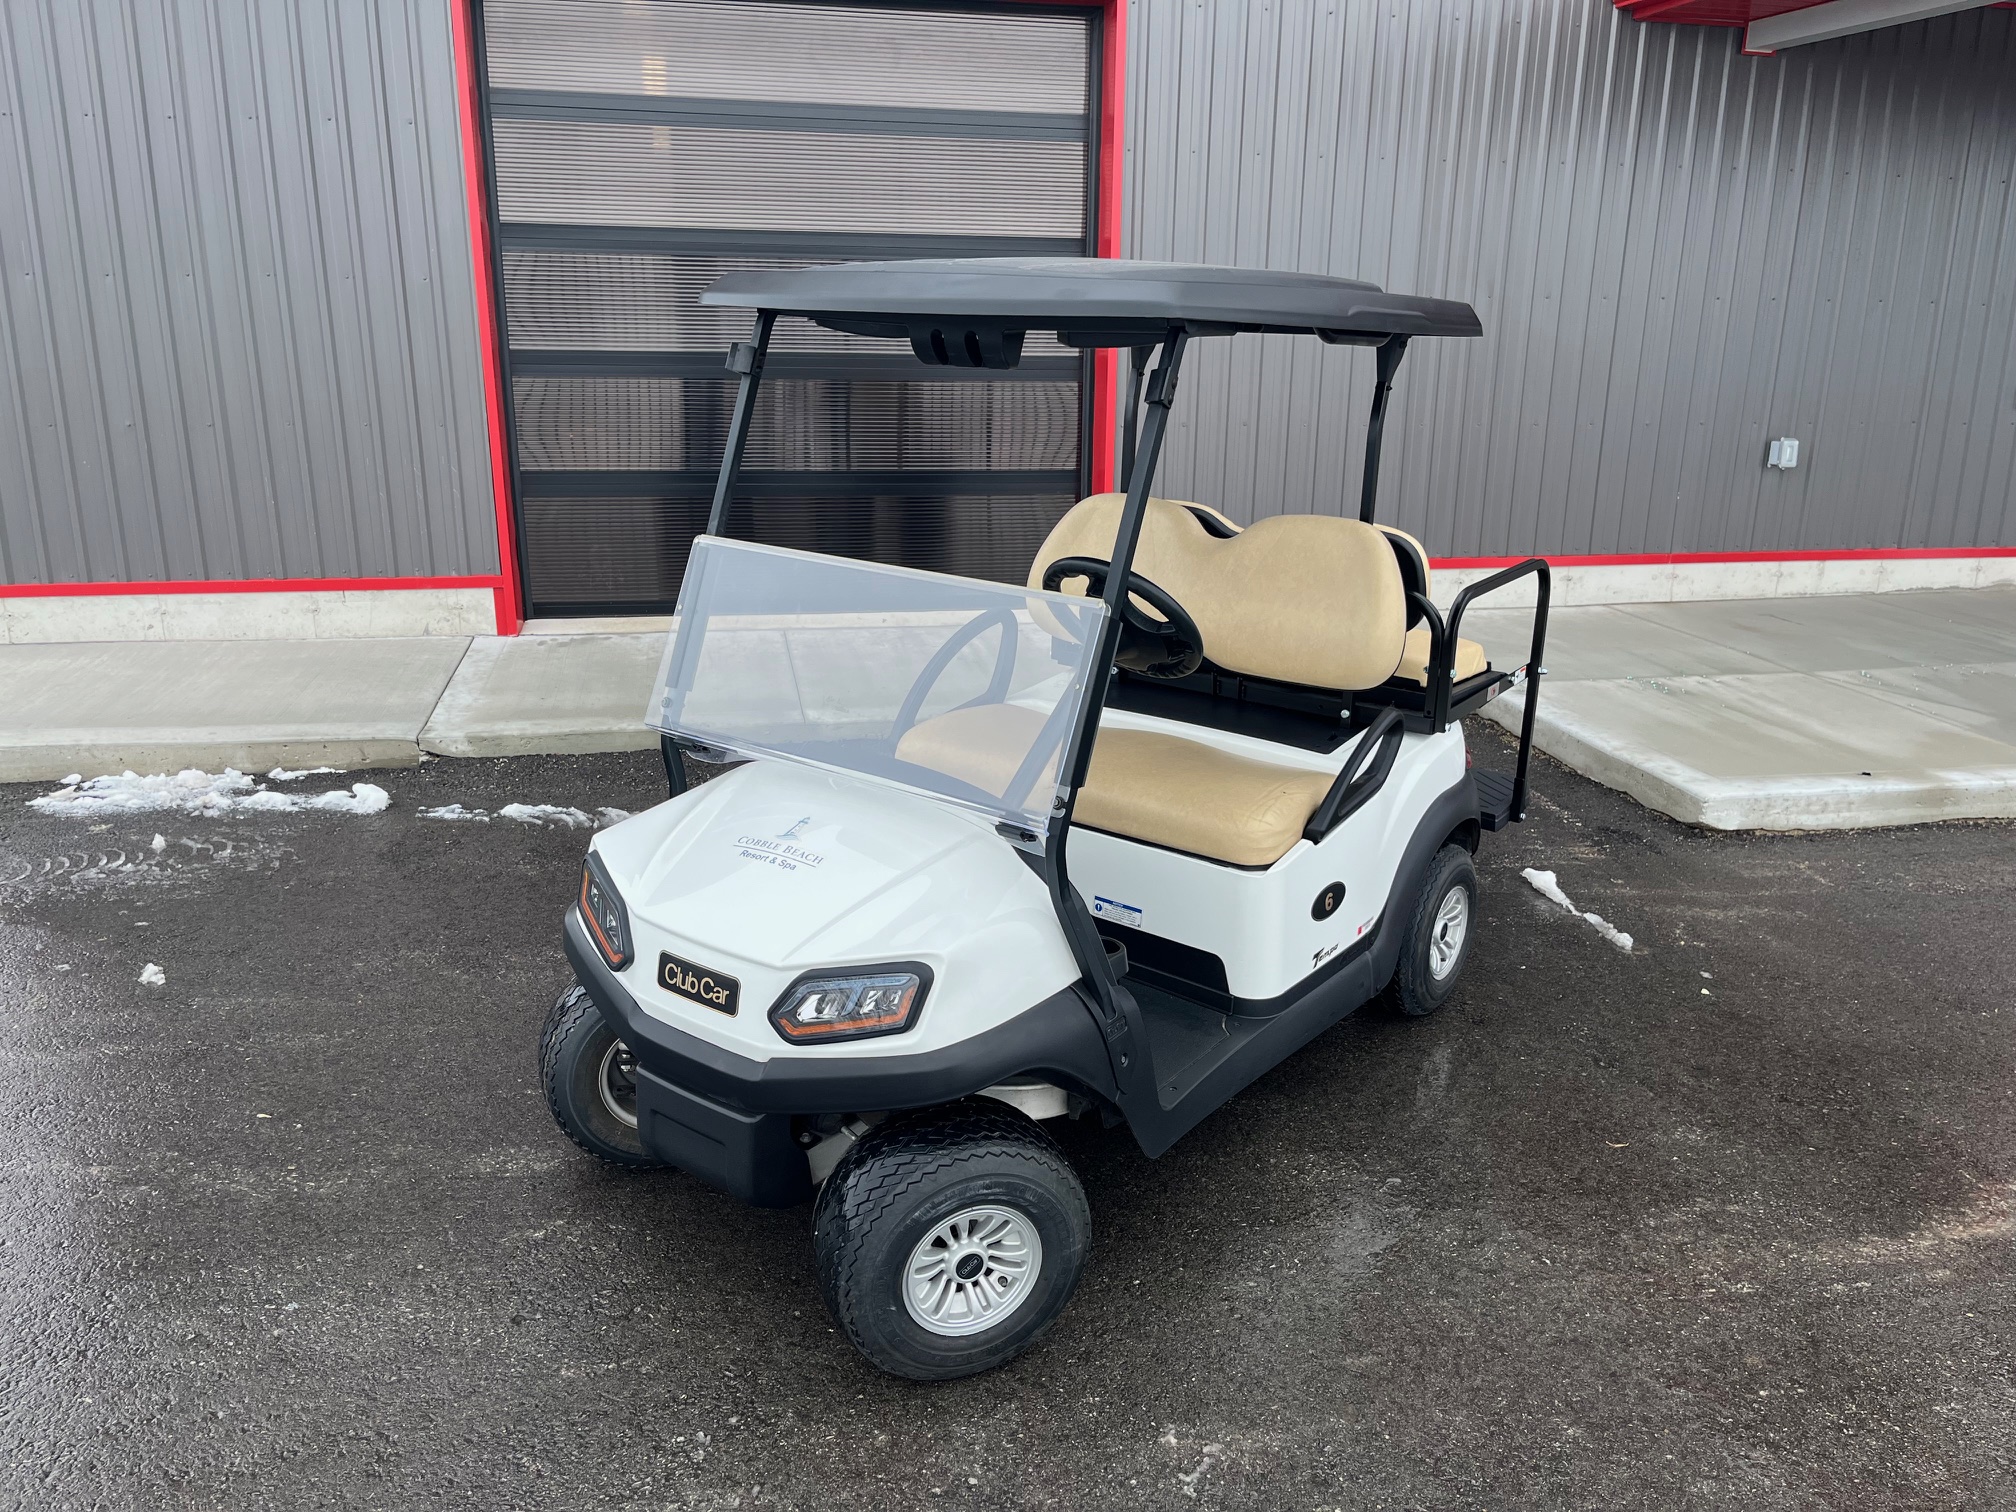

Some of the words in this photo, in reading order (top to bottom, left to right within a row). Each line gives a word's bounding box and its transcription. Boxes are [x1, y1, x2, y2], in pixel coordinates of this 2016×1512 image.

[737, 836, 781, 851] COBBLE
[782, 845, 824, 865] BEACH
[739, 849, 770, 862] Resort
[769, 856, 778, 865] &
[778, 859, 797, 871] Spa
[1325, 892, 1334, 911] 6
[664, 962, 699, 994] Club
[700, 977, 730, 1005] Car
